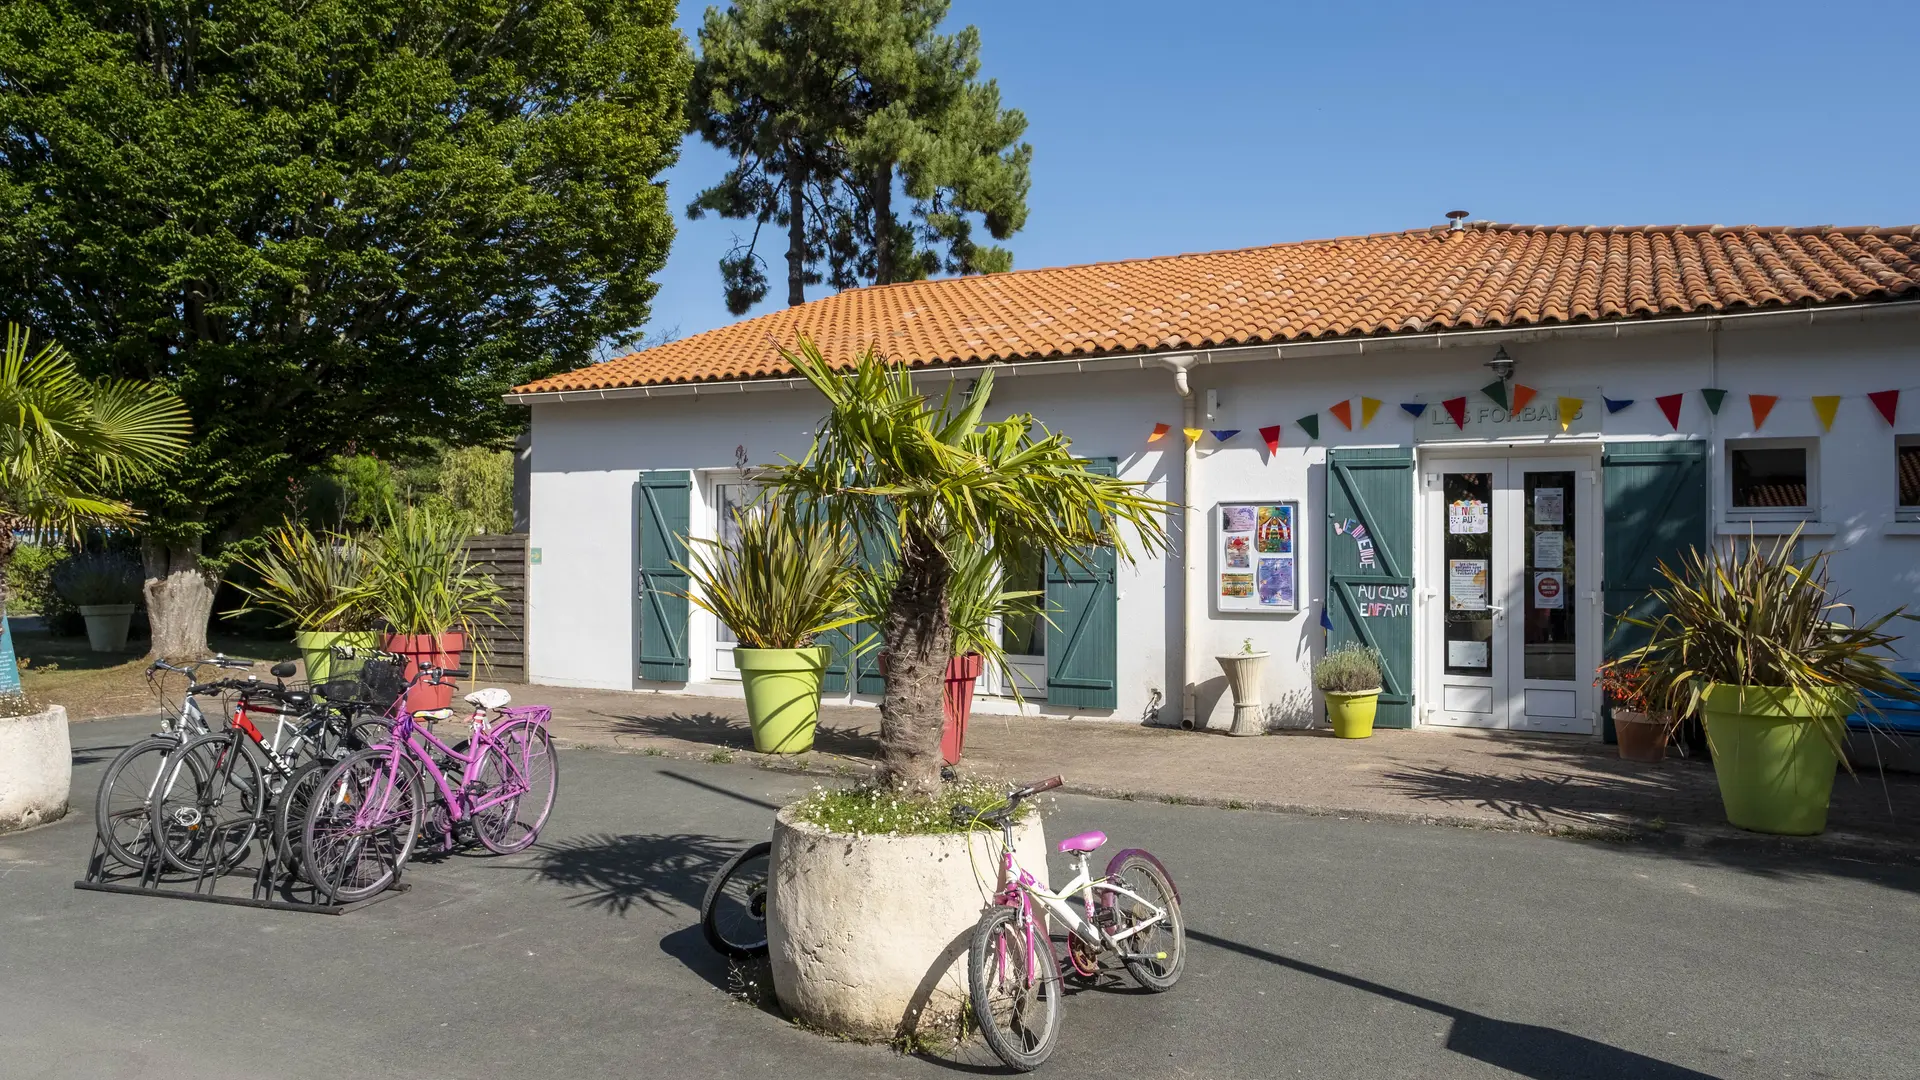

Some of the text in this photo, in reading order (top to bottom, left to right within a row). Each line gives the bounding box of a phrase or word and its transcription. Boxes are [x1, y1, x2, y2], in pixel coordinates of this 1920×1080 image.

[1432, 408, 1472, 425] LES
[1358, 585, 1408, 601] AU CLUB
[1360, 602, 1410, 618] ENFANT
[260, 738, 293, 777] BTWI
